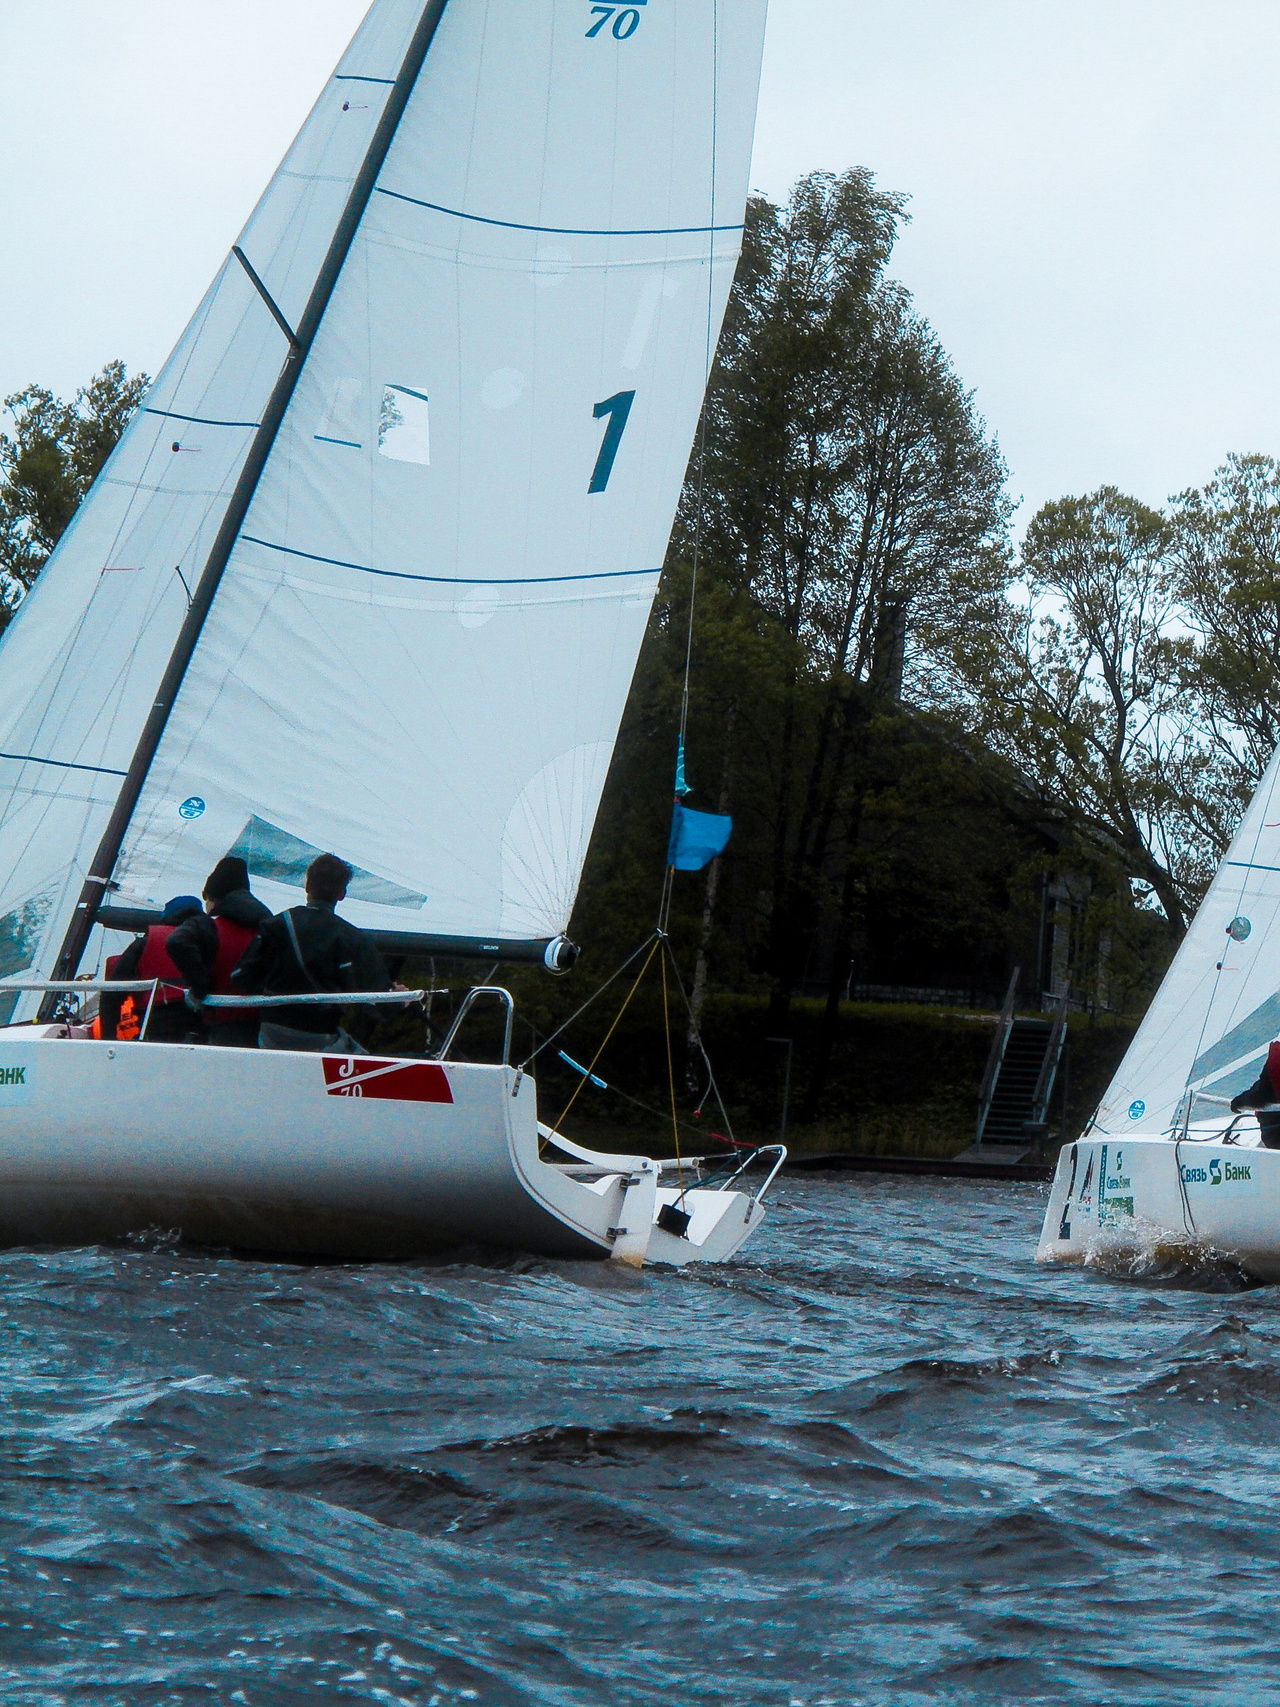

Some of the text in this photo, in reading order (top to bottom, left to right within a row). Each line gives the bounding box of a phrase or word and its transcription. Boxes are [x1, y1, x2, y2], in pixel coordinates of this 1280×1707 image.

[584, 6, 640, 40] 70
[587, 389, 636, 494] 1
[339, 1058, 355, 1078] J
[341, 1083, 363, 1098] 70
[1180, 1162, 1252, 1183] Связь Банк
